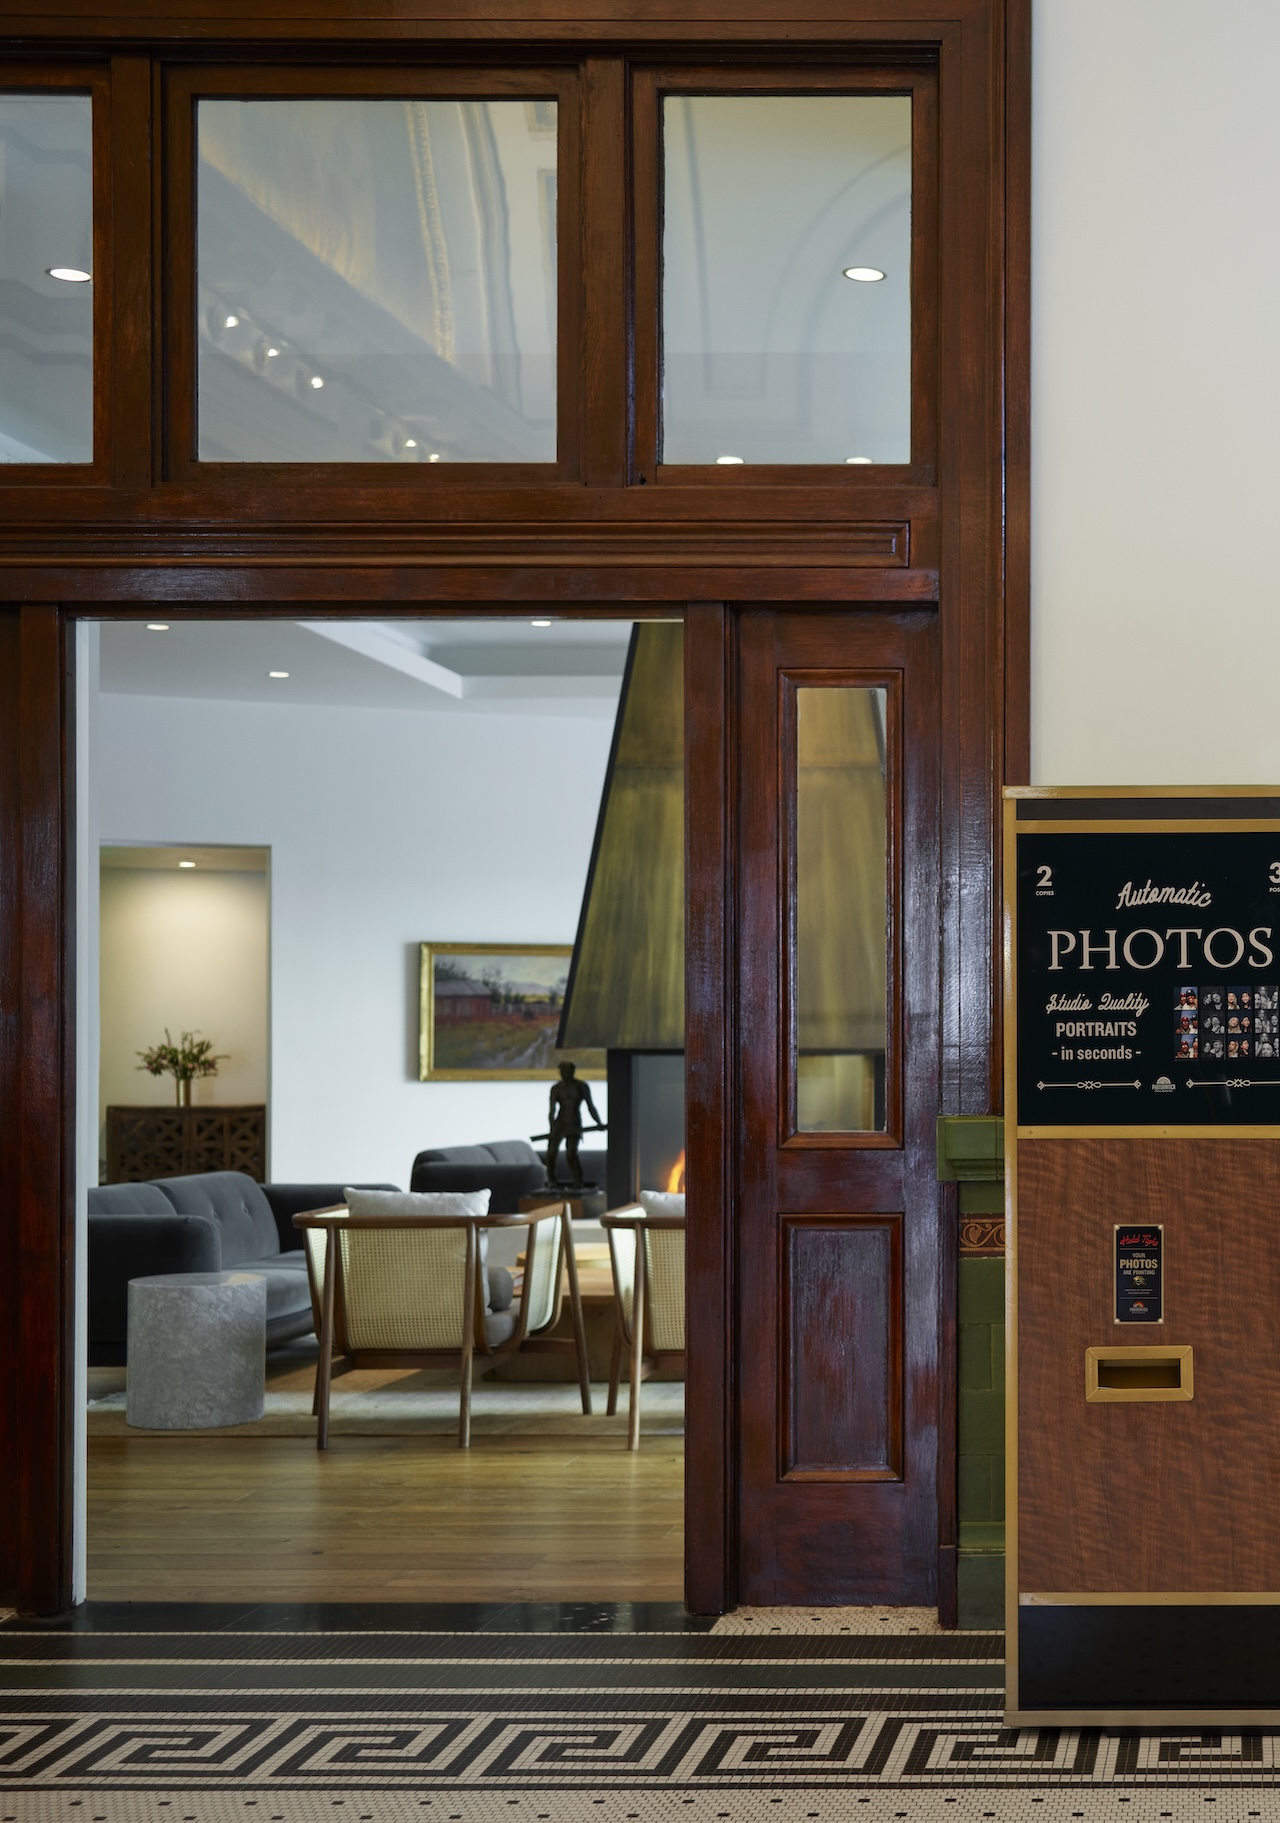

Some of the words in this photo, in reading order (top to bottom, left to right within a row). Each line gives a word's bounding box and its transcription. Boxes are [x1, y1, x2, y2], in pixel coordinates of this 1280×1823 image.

[1036, 865, 1053, 887] 2
[1115, 879, 1212, 910] Automatic
[1046, 927, 1274, 970] PHOTOS
[1045, 993, 1093, 1014] Studio
[1098, 992, 1150, 1018] Quality
[1055, 1021, 1137, 1037] PORTRAITS
[1077, 1045, 1133, 1060] seconds
[1119, 1259, 1158, 1269] PHOTOS
